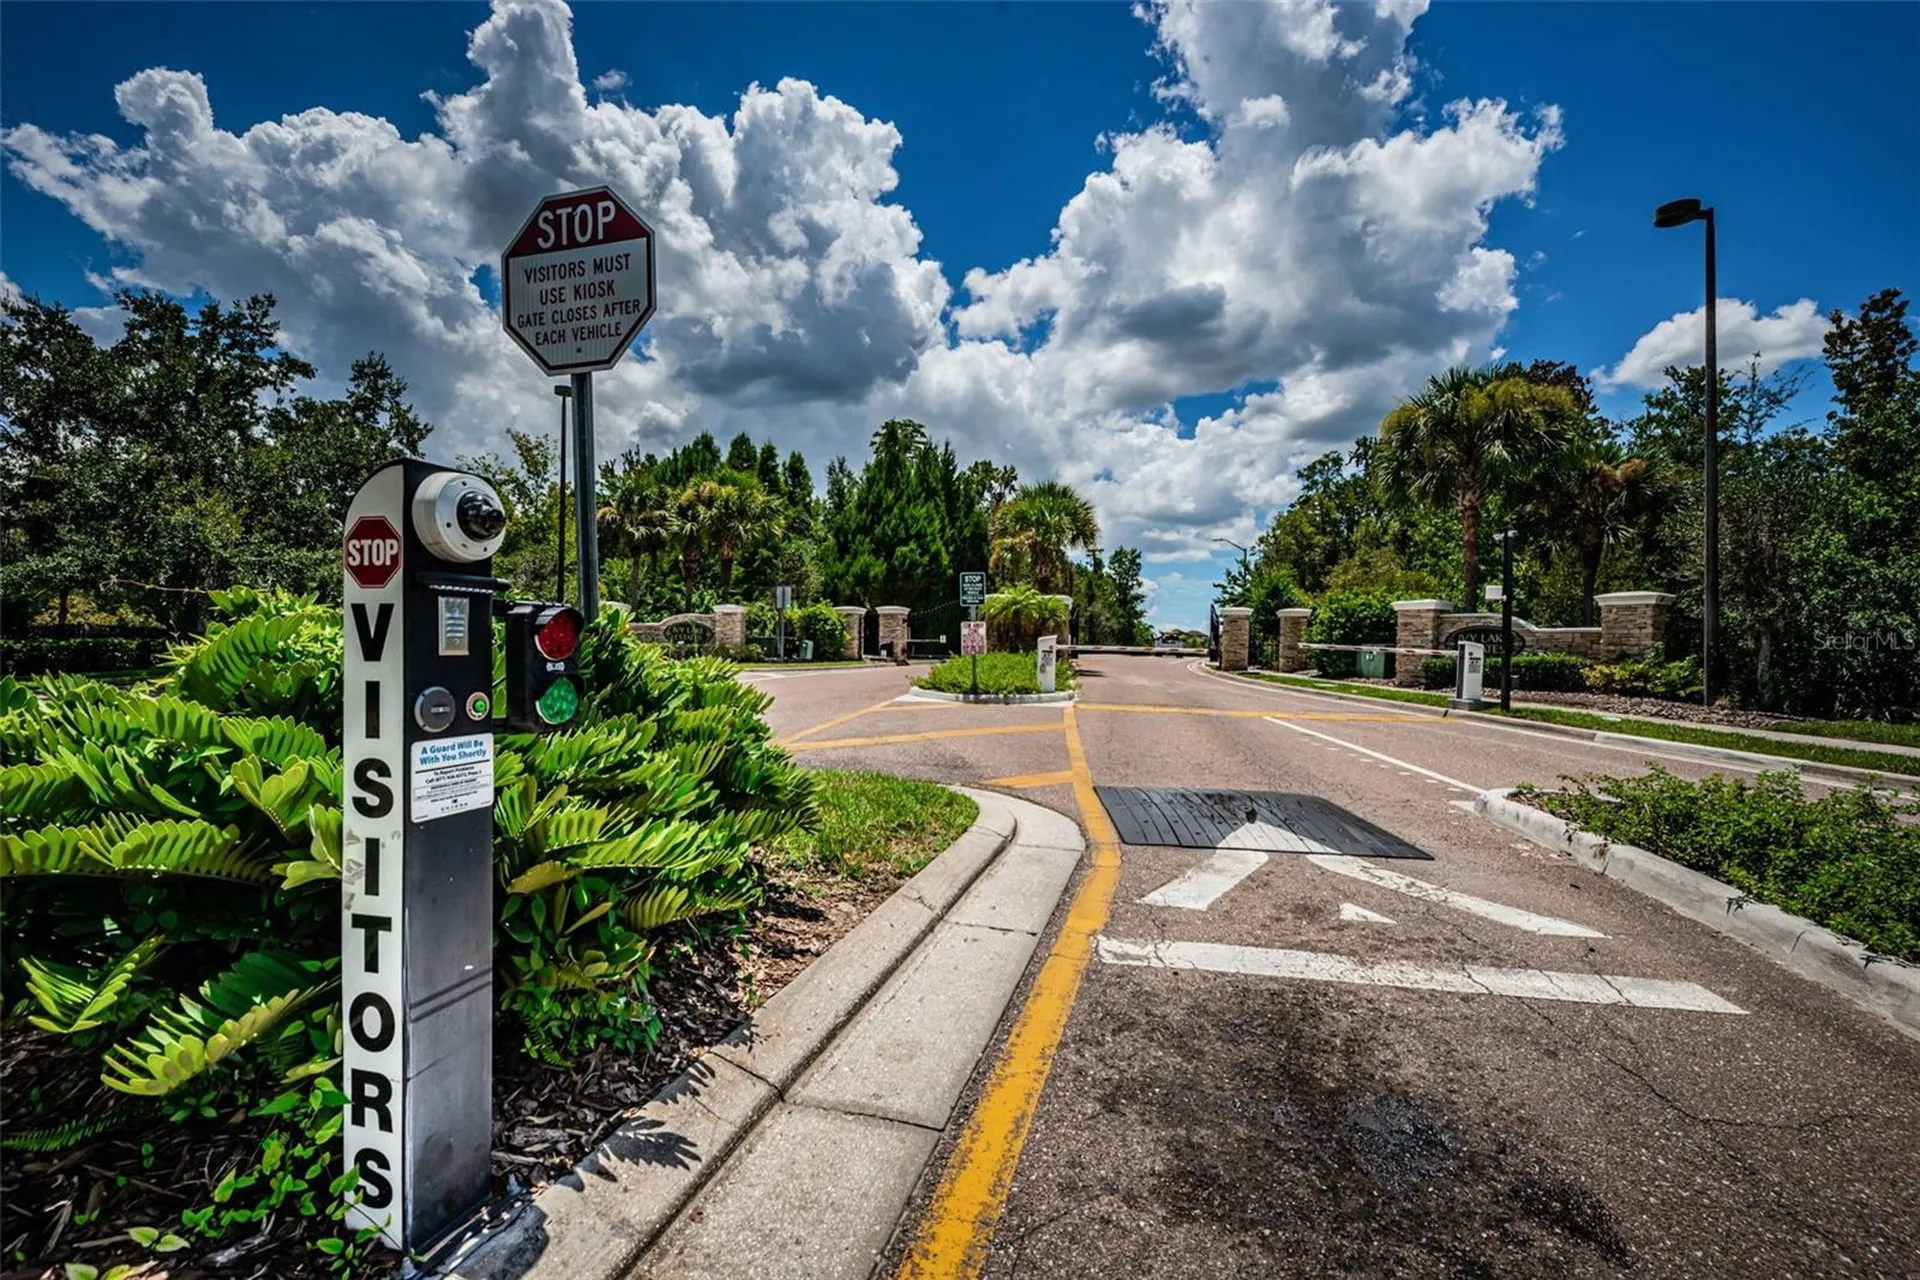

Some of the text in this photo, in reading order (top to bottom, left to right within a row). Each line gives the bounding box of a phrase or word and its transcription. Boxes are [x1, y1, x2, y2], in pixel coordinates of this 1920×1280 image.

[537, 201, 616, 249] STOP
[524, 253, 631, 285] VISITORS MUST
[539, 280, 616, 306] USE KIOSK
[517, 299, 641, 329] GATE CLOSES AFTER
[535, 322, 622, 346] EACH VEHICLE
[348, 538, 399, 567] STOP
[964, 575, 981, 583] STOP
[1481, 633, 1503, 643] LAK
[420, 748, 486, 765] With You Shortly
[421, 739, 483, 755] A Guard Will Be
[348, 603, 396, 1210] VISITORS
